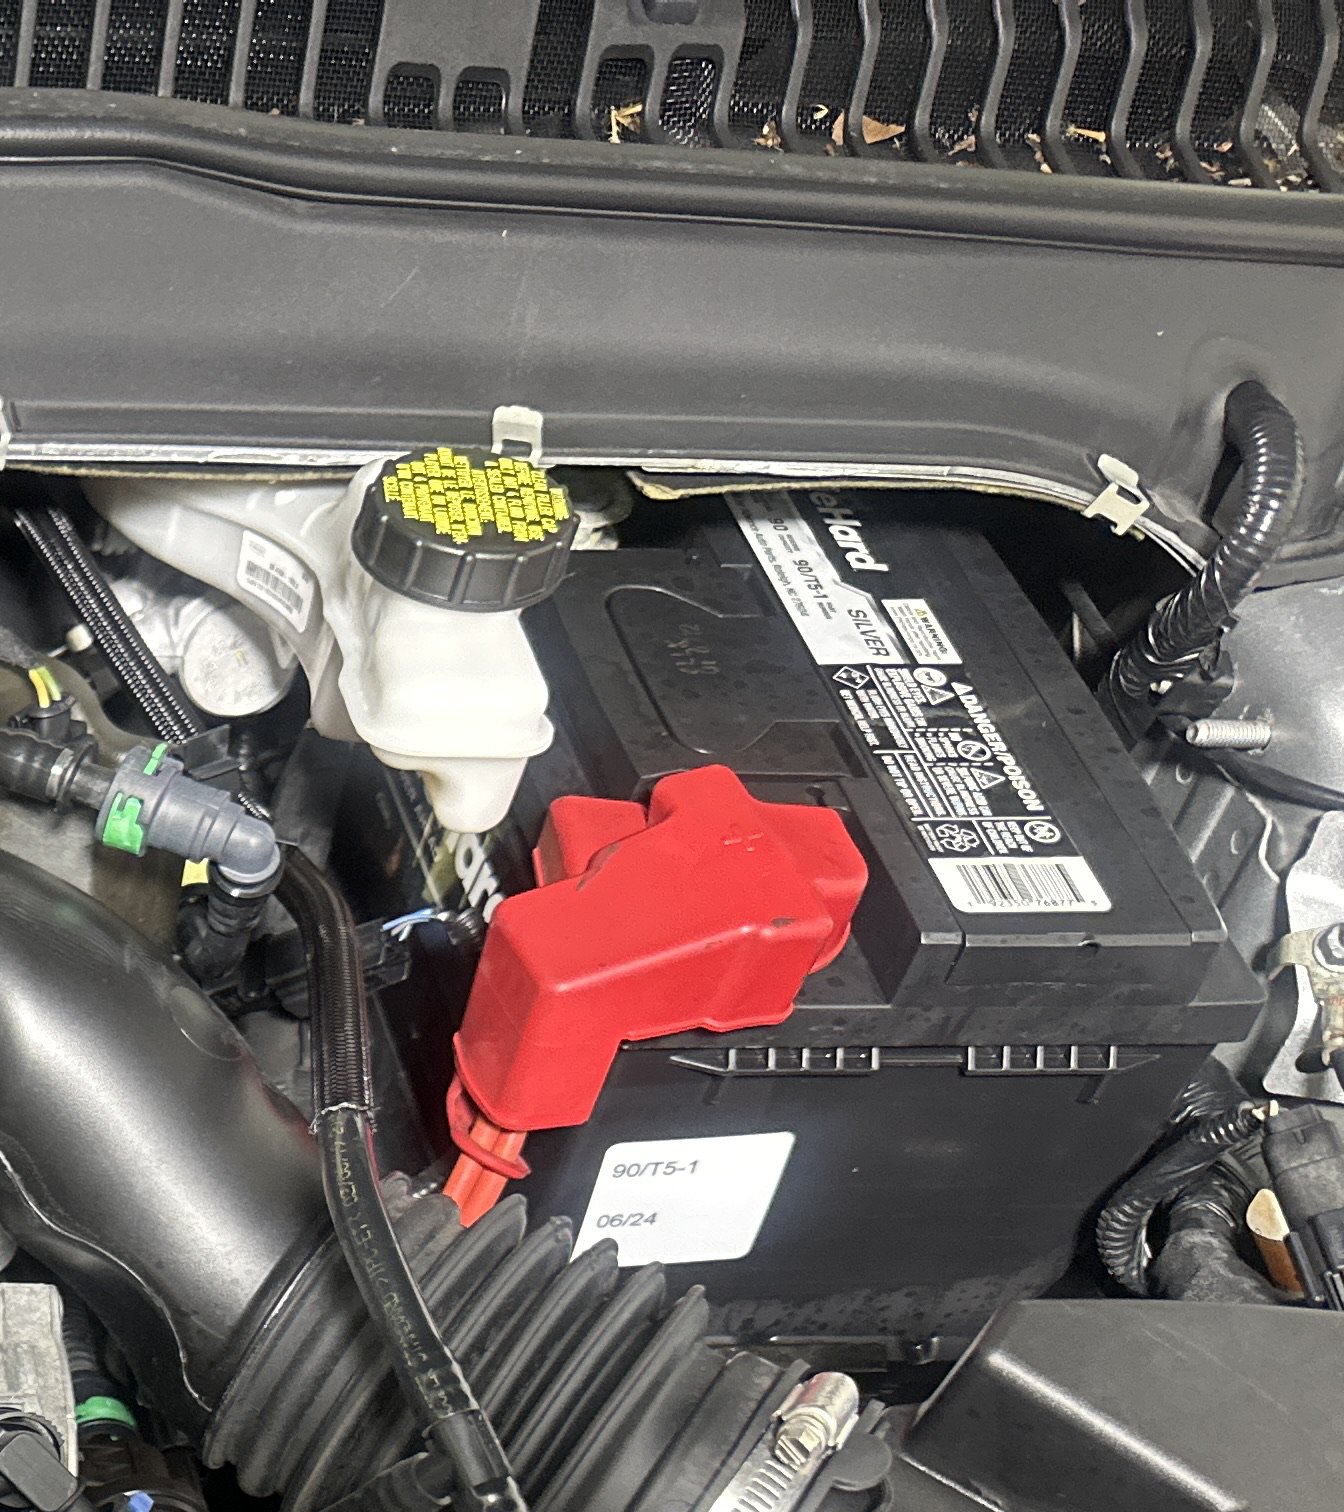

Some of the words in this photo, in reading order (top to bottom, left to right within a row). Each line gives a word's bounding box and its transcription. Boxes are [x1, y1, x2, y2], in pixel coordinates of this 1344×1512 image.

[768, 518, 789, 532] 90
[792, 559, 829, 599] 90/T5-1
[812, 492, 889, 572] eHard
[847, 609, 891, 657] SILVER
[964, 695, 1045, 811] DANGER/POISON
[612, 1159, 700, 1180] 90/T5-1
[595, 1211, 658, 1229] 06/24
